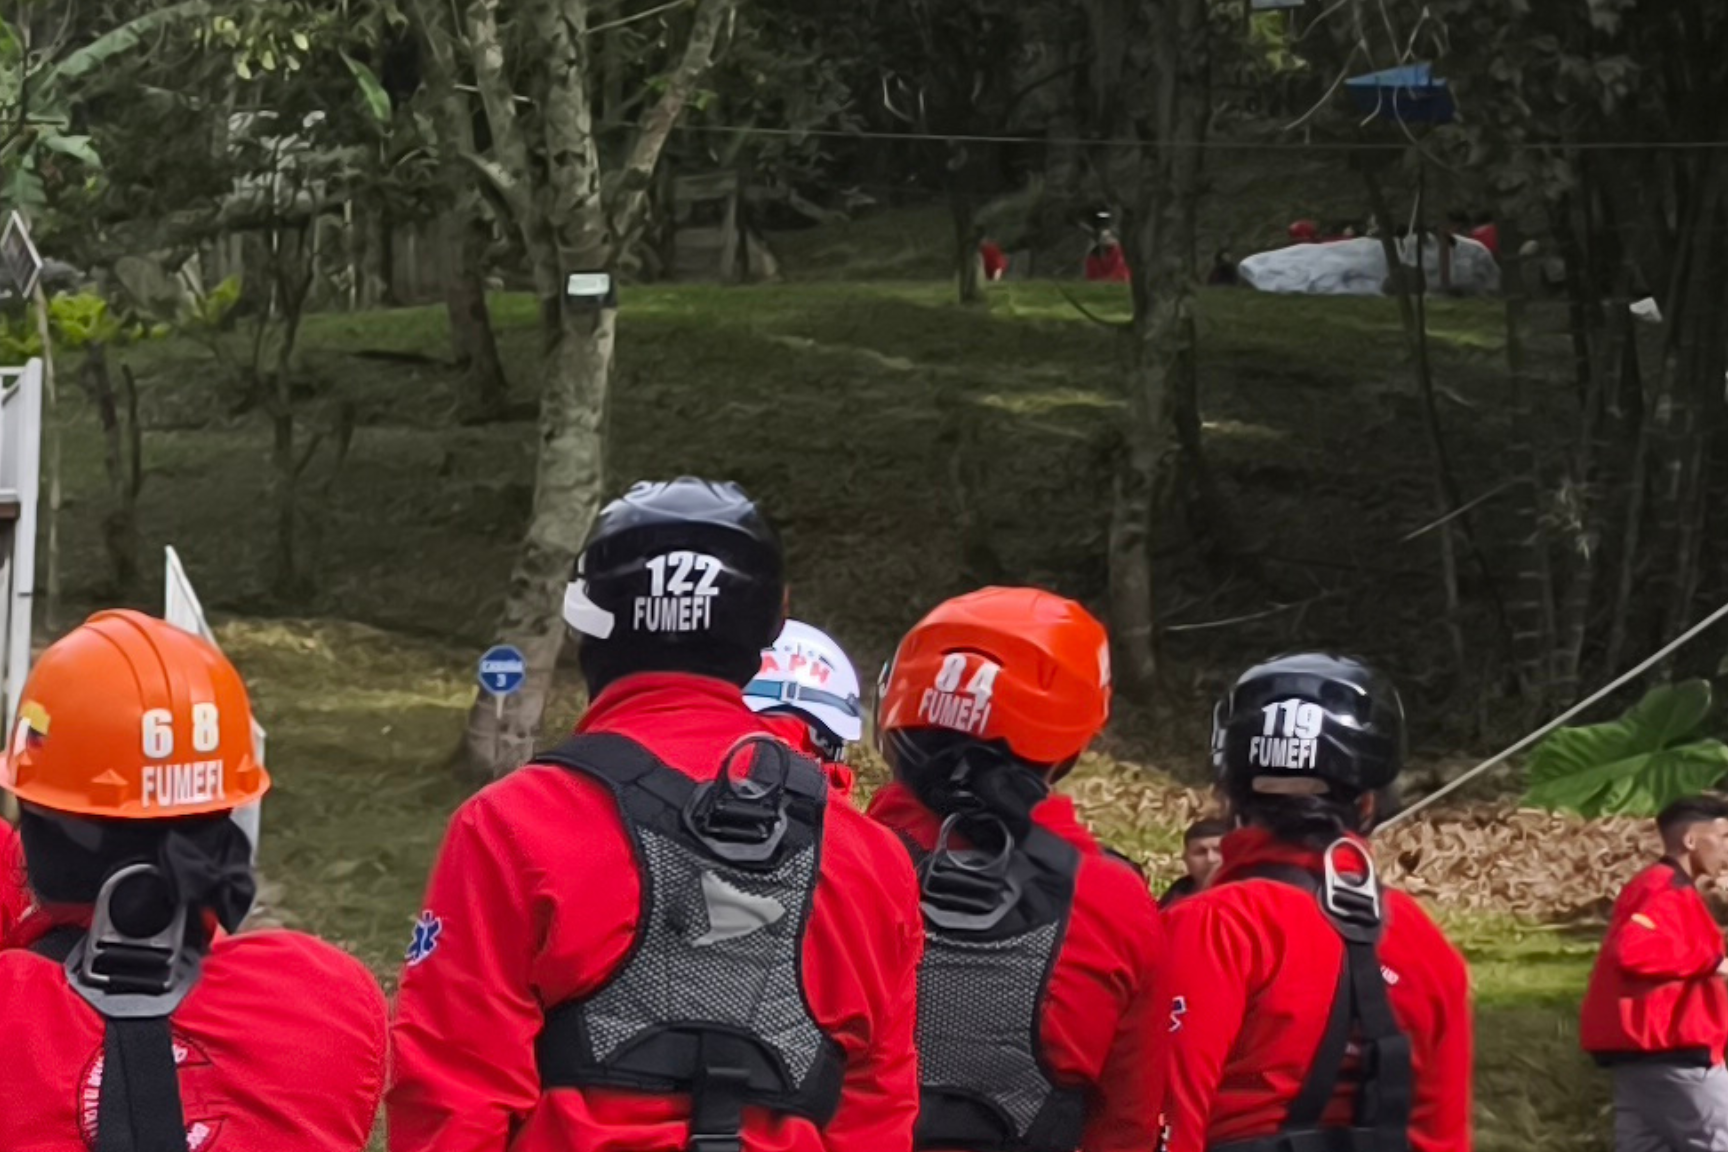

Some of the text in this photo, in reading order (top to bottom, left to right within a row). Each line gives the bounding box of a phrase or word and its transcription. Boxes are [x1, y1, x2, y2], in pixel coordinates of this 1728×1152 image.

[646, 551, 723, 596] 122
[633, 596, 712, 631] FUMEFI
[918, 687, 991, 734] FUMEFI
[1262, 698, 1322, 738] 119
[1249, 736, 1317, 769] FUMEFI
[142, 759, 225, 808] FUMEFI
